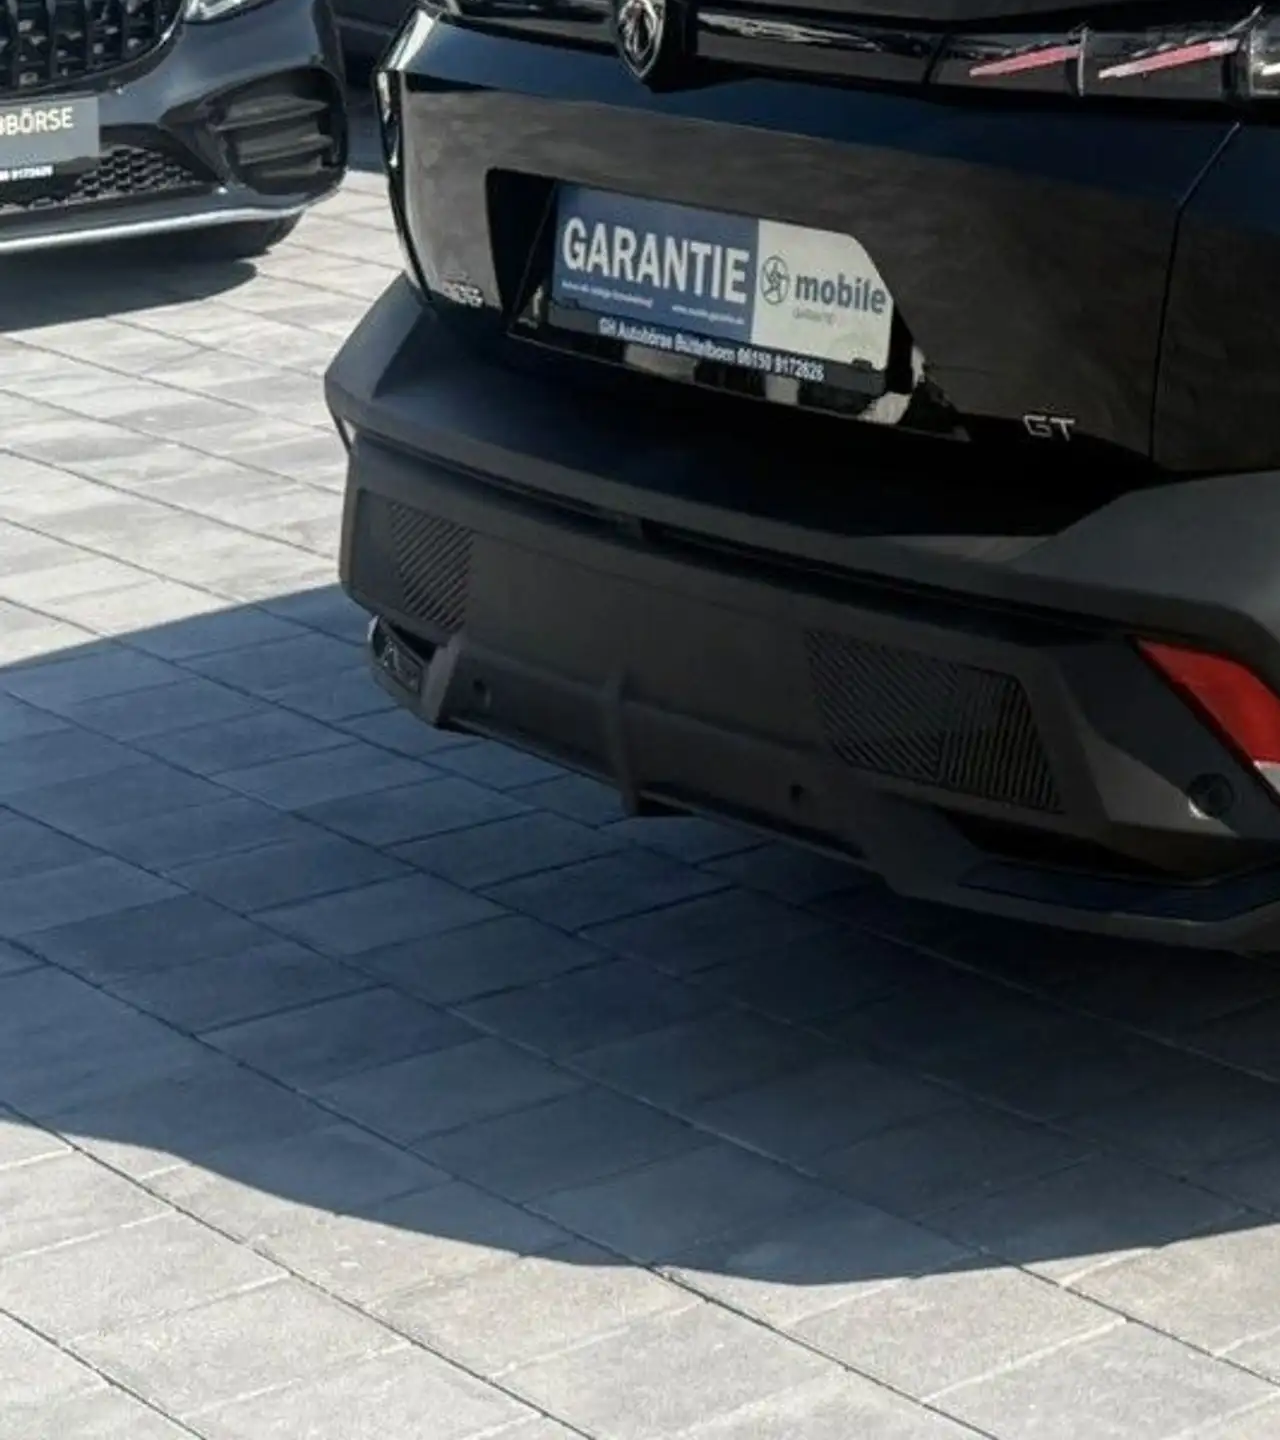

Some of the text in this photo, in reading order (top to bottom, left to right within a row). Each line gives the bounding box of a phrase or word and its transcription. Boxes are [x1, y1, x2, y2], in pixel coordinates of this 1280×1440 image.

[562, 217, 749, 303] GARANTIE
[795, 272, 887, 315] mobile
[599, 316, 617, 334] GH
[1023, 415, 1075, 441] GT
